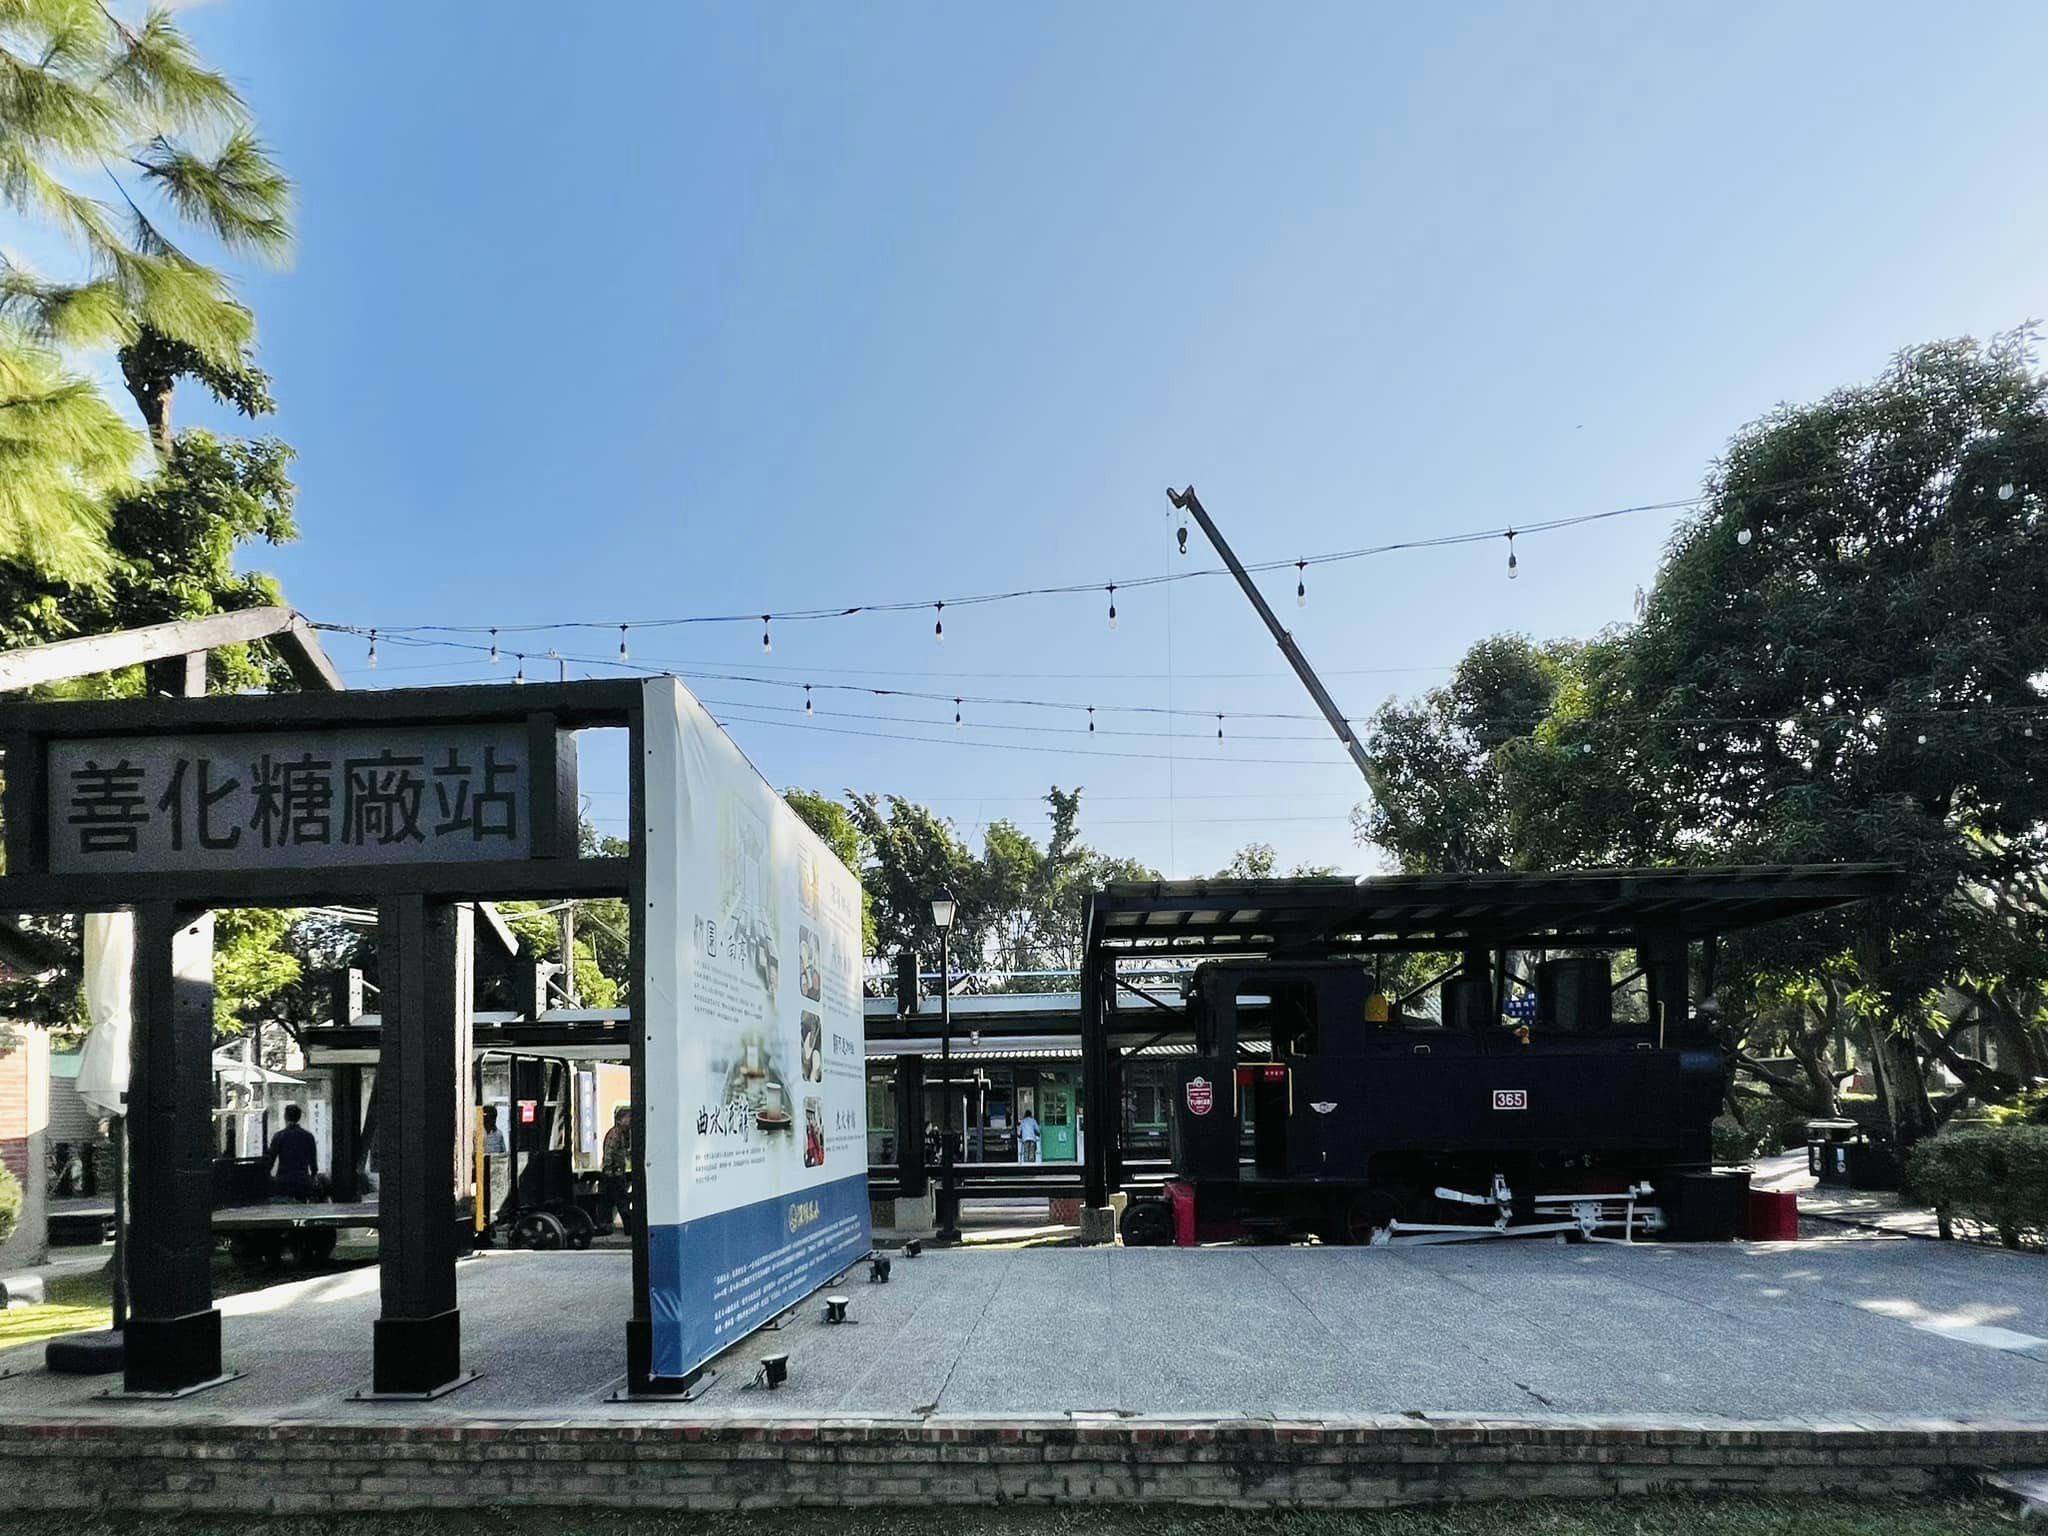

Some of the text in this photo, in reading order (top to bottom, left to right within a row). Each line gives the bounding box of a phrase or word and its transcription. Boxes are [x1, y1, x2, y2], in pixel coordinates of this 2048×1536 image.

[68, 746, 518, 853] 善化糖廠站
[1497, 1093, 1522, 1106] 365
